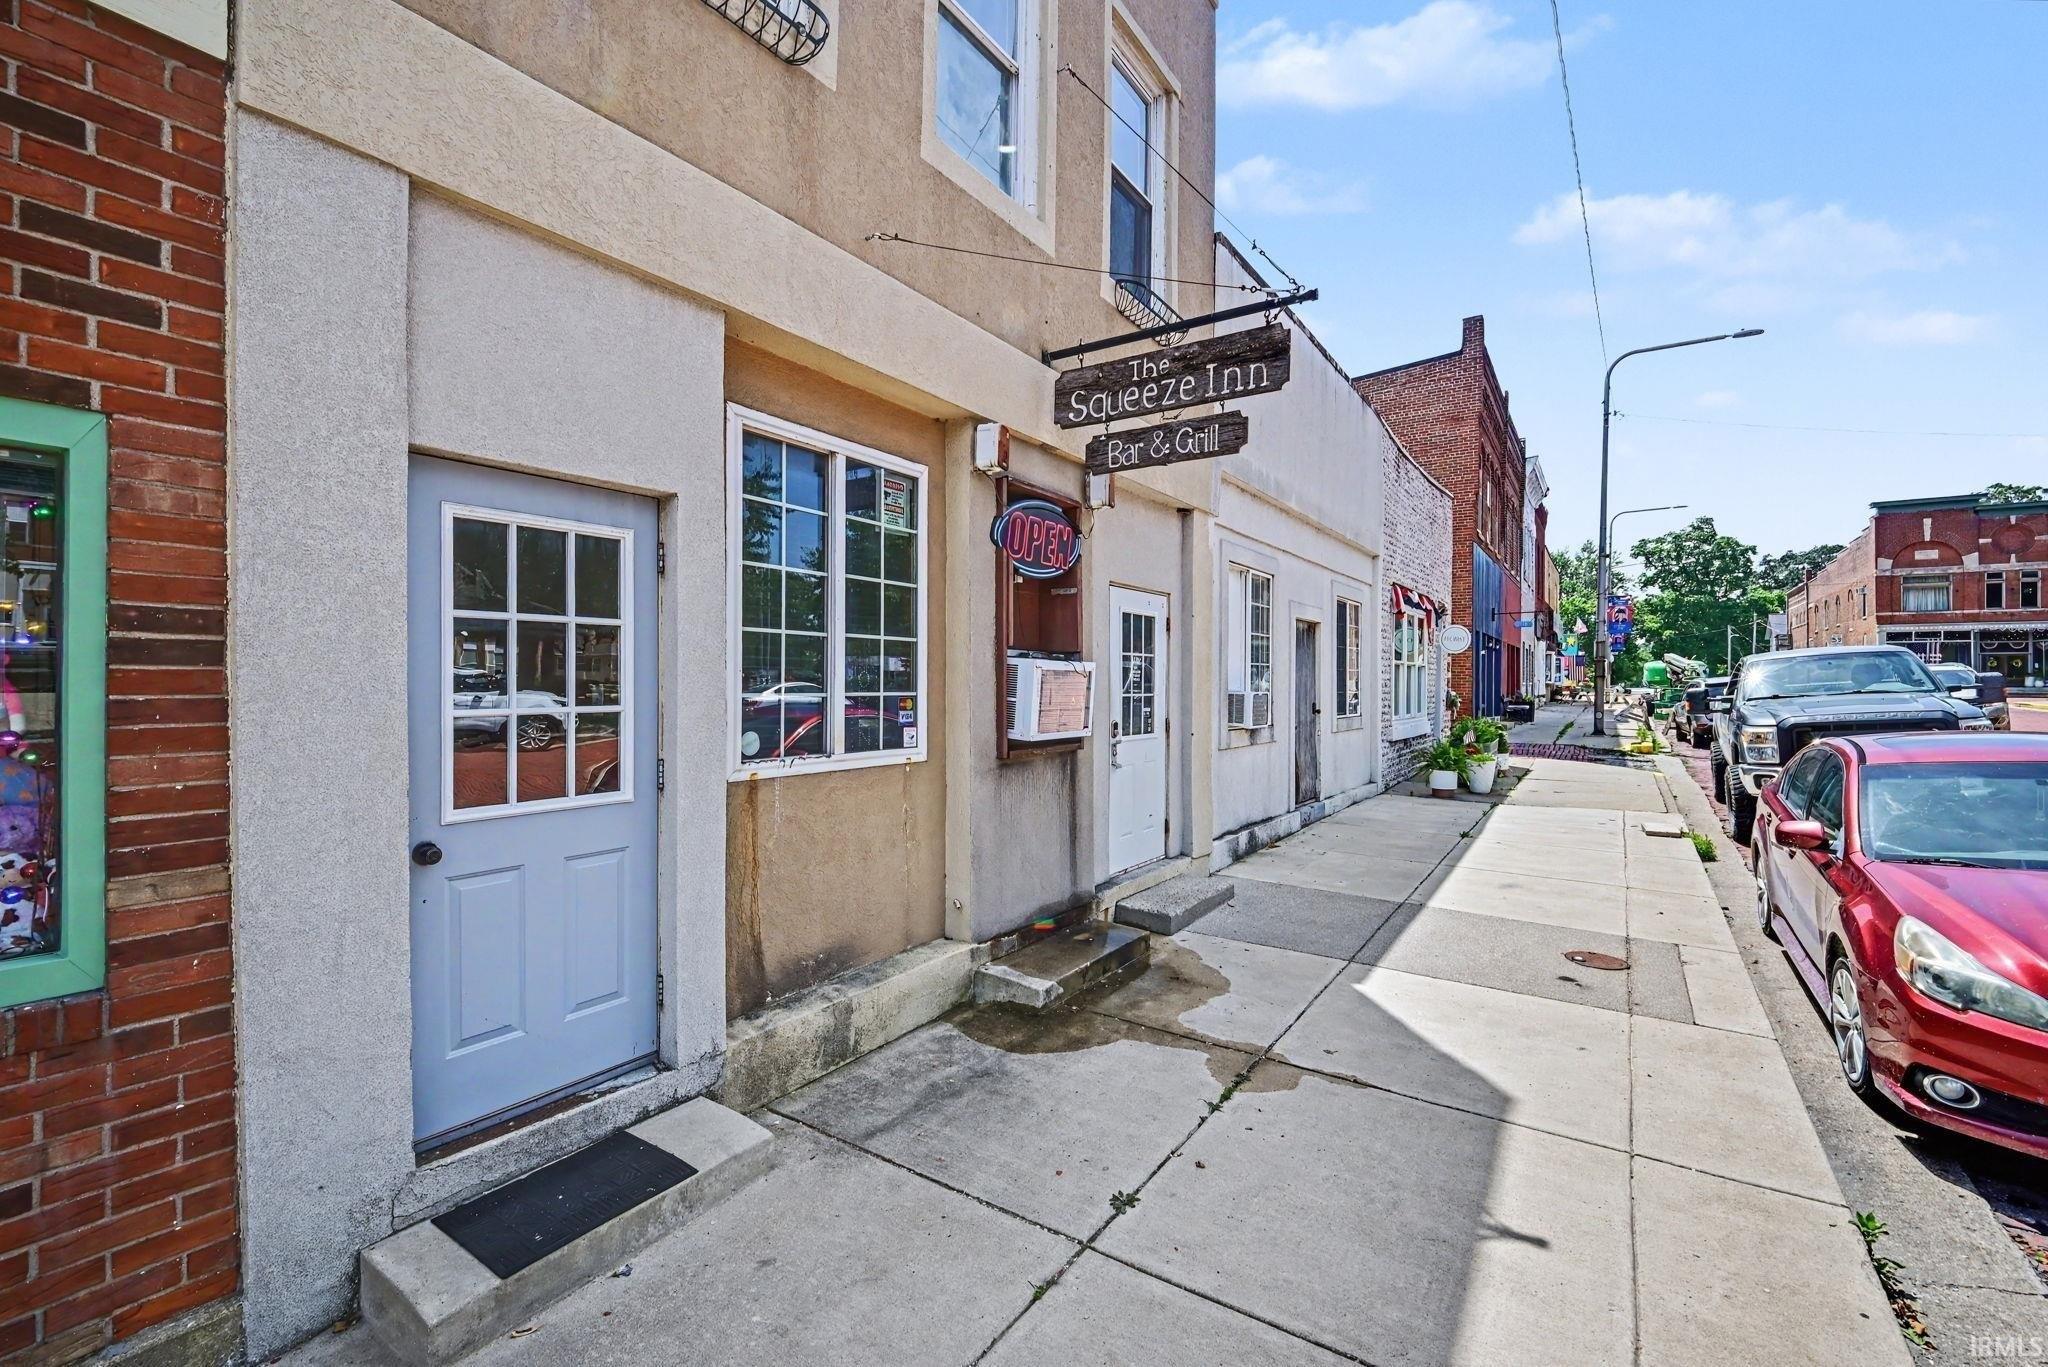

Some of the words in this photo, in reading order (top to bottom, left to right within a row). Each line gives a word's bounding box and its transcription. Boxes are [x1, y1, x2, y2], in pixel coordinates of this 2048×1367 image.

[1068, 374, 1196, 422] Squeeze
[1204, 362, 1270, 398] Inn
[1129, 358, 1170, 381] The
[1108, 439, 1144, 468] Bar
[1150, 430, 1170, 458] &
[1175, 424, 1219, 454] Grill
[1007, 511, 1072, 570] OPEN
